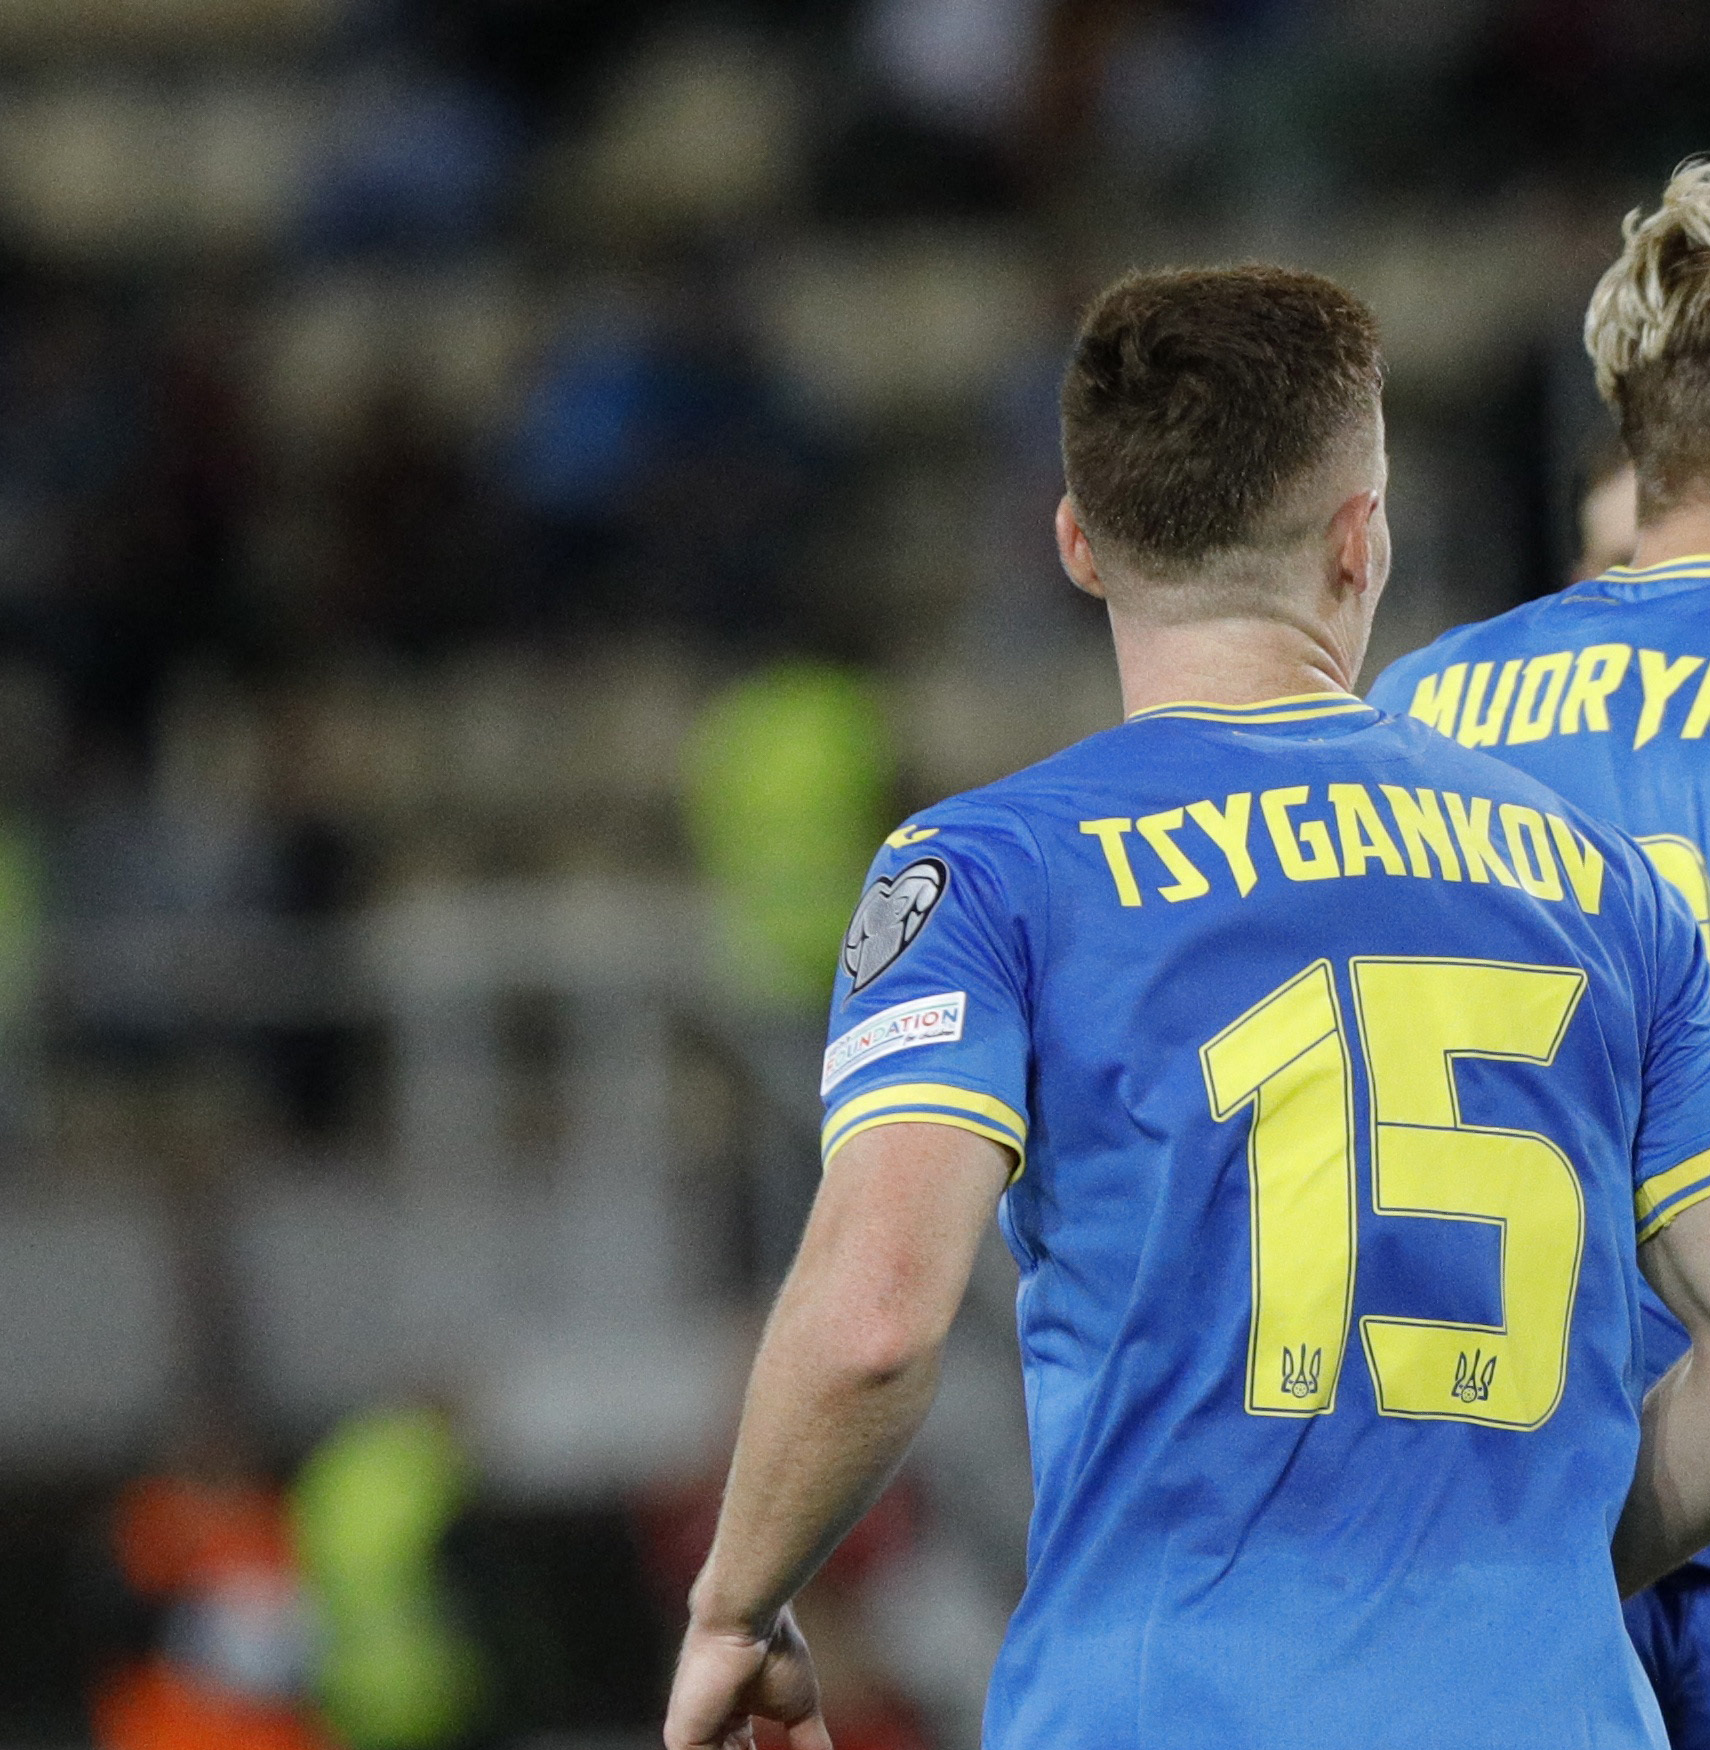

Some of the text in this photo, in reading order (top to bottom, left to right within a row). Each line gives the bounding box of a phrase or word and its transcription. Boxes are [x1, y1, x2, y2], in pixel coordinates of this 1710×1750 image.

[1079, 783, 1604, 914] TSYGANKOV
[826, 1007, 958, 1076] FOUNDATION
[1200, 956, 1589, 1430] 15
